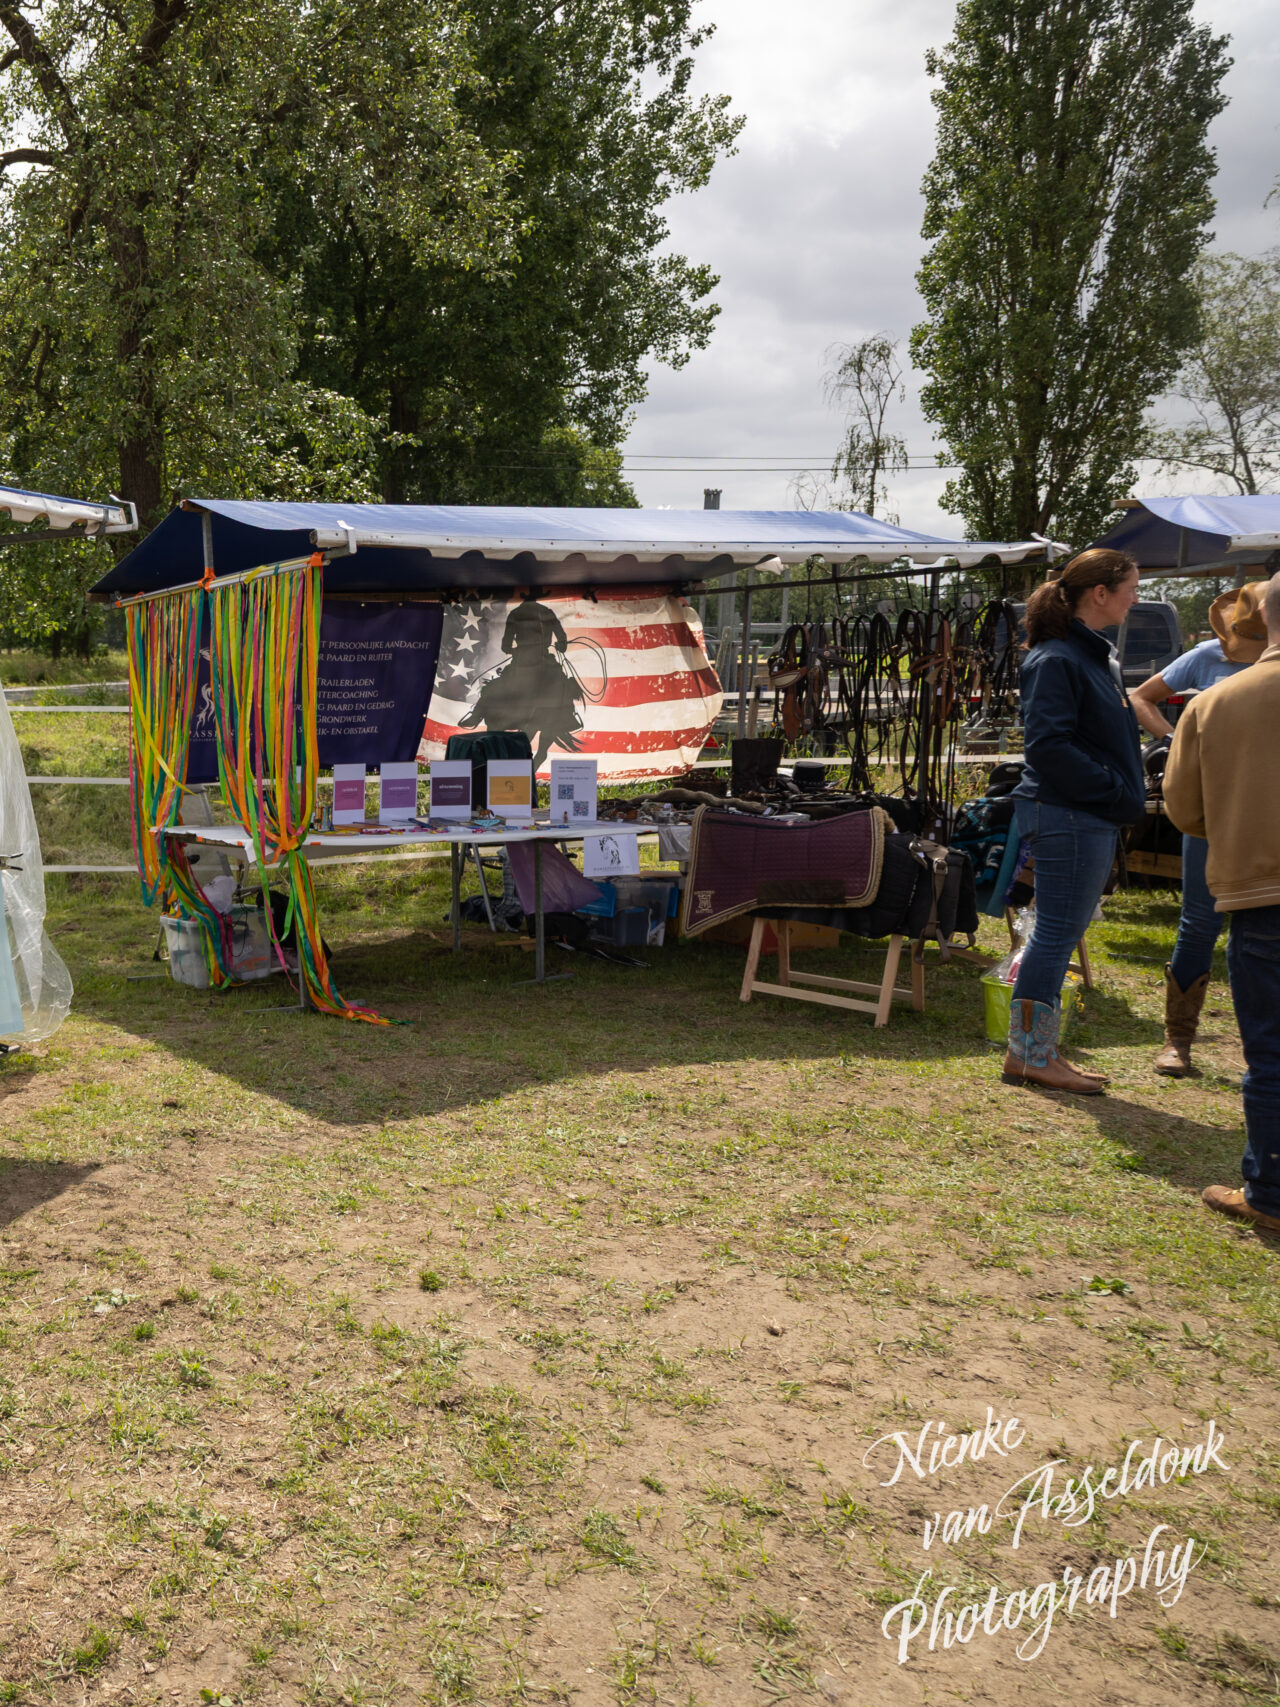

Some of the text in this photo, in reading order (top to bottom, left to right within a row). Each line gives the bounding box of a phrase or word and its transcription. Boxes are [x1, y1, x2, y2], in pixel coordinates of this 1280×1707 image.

[329, 640, 384, 650] PERSOONLIJKE
[385, 641, 431, 650] AANDACHT
[326, 653, 356, 662] PAARD
[356, 653, 367, 662] EN
[368, 653, 393, 661] RUITER
[316, 677, 375, 687] TRAILERLADEN
[317, 690, 379, 699] ITERCOACHING
[327, 703, 354, 712] PAARD
[355, 703, 366, 711] EN
[367, 701, 395, 710] GEDRAG
[317, 714, 368, 724] GRONDWERK
[331, 727, 343, 736] EN
[344, 726, 379, 735] OBSTAKEL
